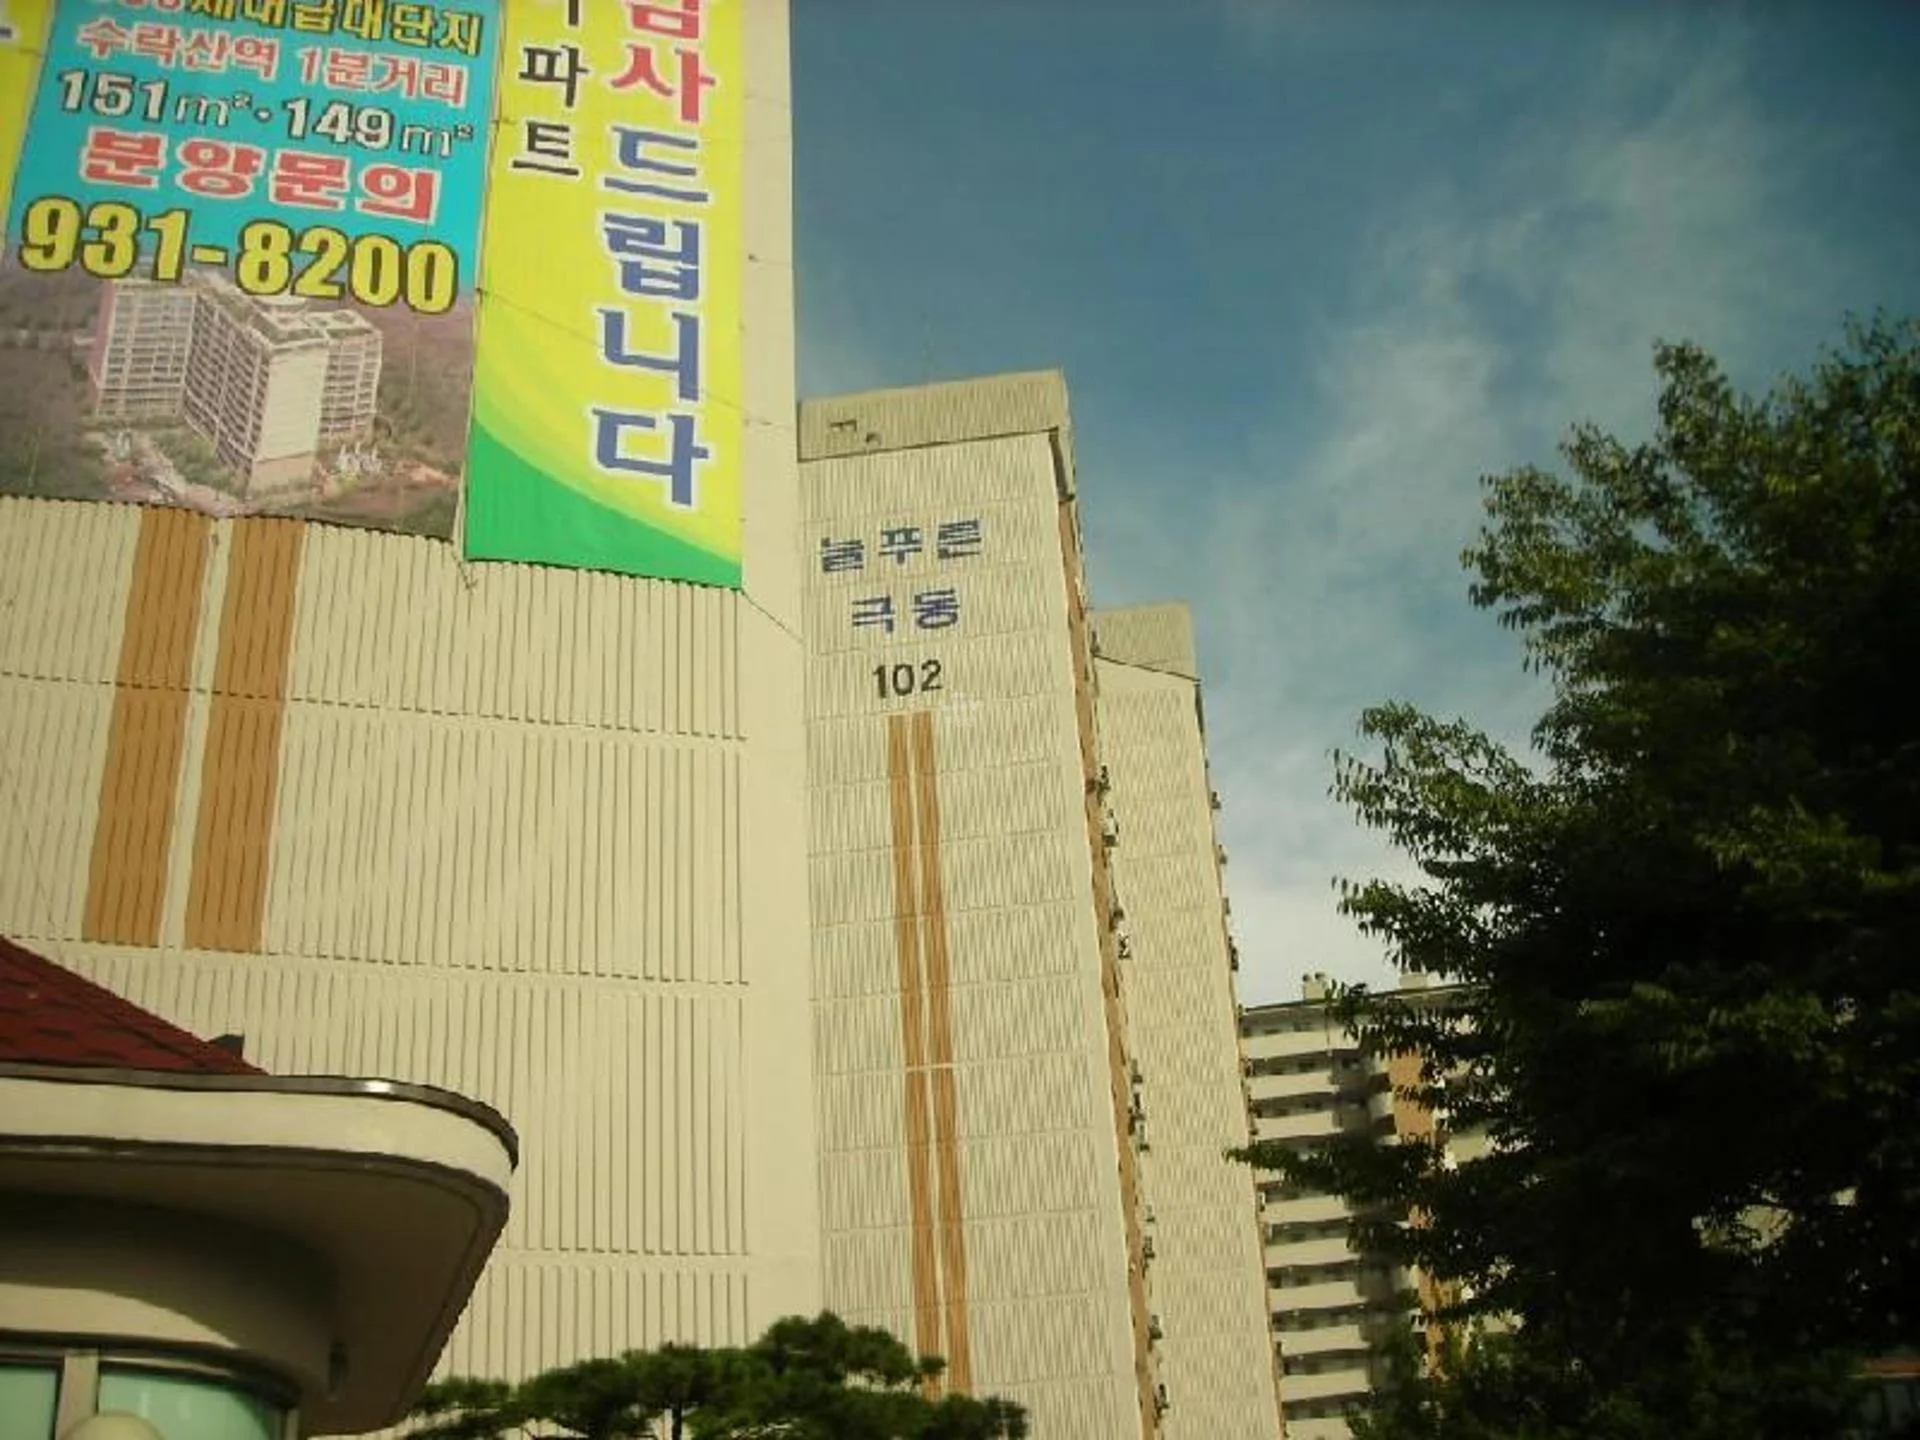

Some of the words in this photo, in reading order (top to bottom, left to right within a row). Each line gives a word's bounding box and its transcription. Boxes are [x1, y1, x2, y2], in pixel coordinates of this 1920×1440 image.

[78, 19, 280, 81] 수락산역
[299, 47, 468, 108] 1분거리
[510, 0, 590, 177] 파트
[79, 126, 442, 225] 분양문의
[18, 195, 459, 315] 931-8200
[820, 518, 983, 574] 늘푸른
[851, 588, 961, 634] 극동
[872, 658, 944, 699] 102
